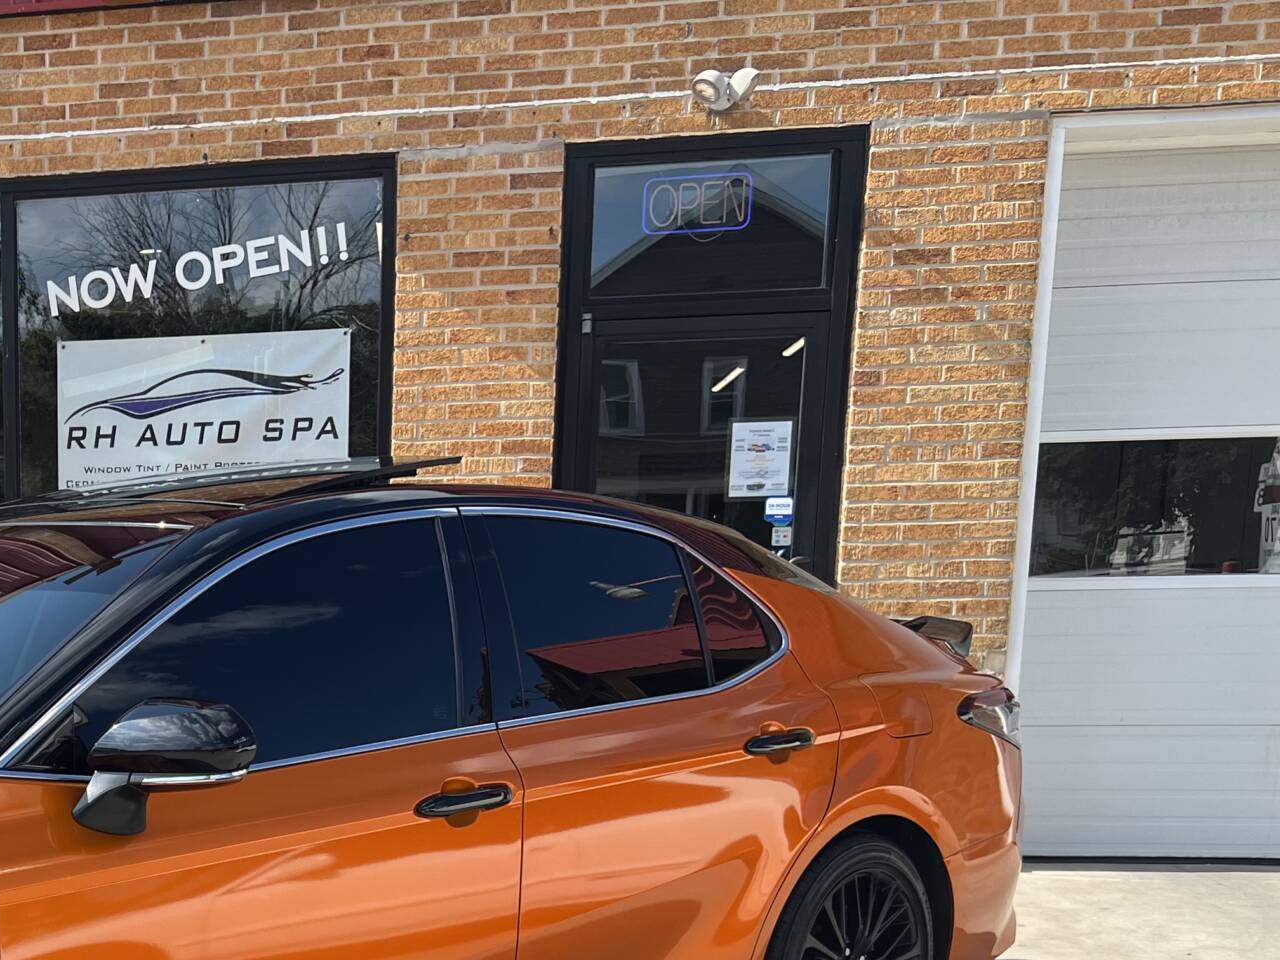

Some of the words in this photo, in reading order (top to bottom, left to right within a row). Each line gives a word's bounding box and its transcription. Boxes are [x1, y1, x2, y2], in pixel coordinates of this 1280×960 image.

[649, 178, 746, 228] OPEN
[46, 259, 157, 318] NOW
[174, 222, 350, 291] OPEN!!
[66, 424, 118, 450] RH
[135, 419, 242, 448] AUTO
[262, 415, 340, 443] SPA
